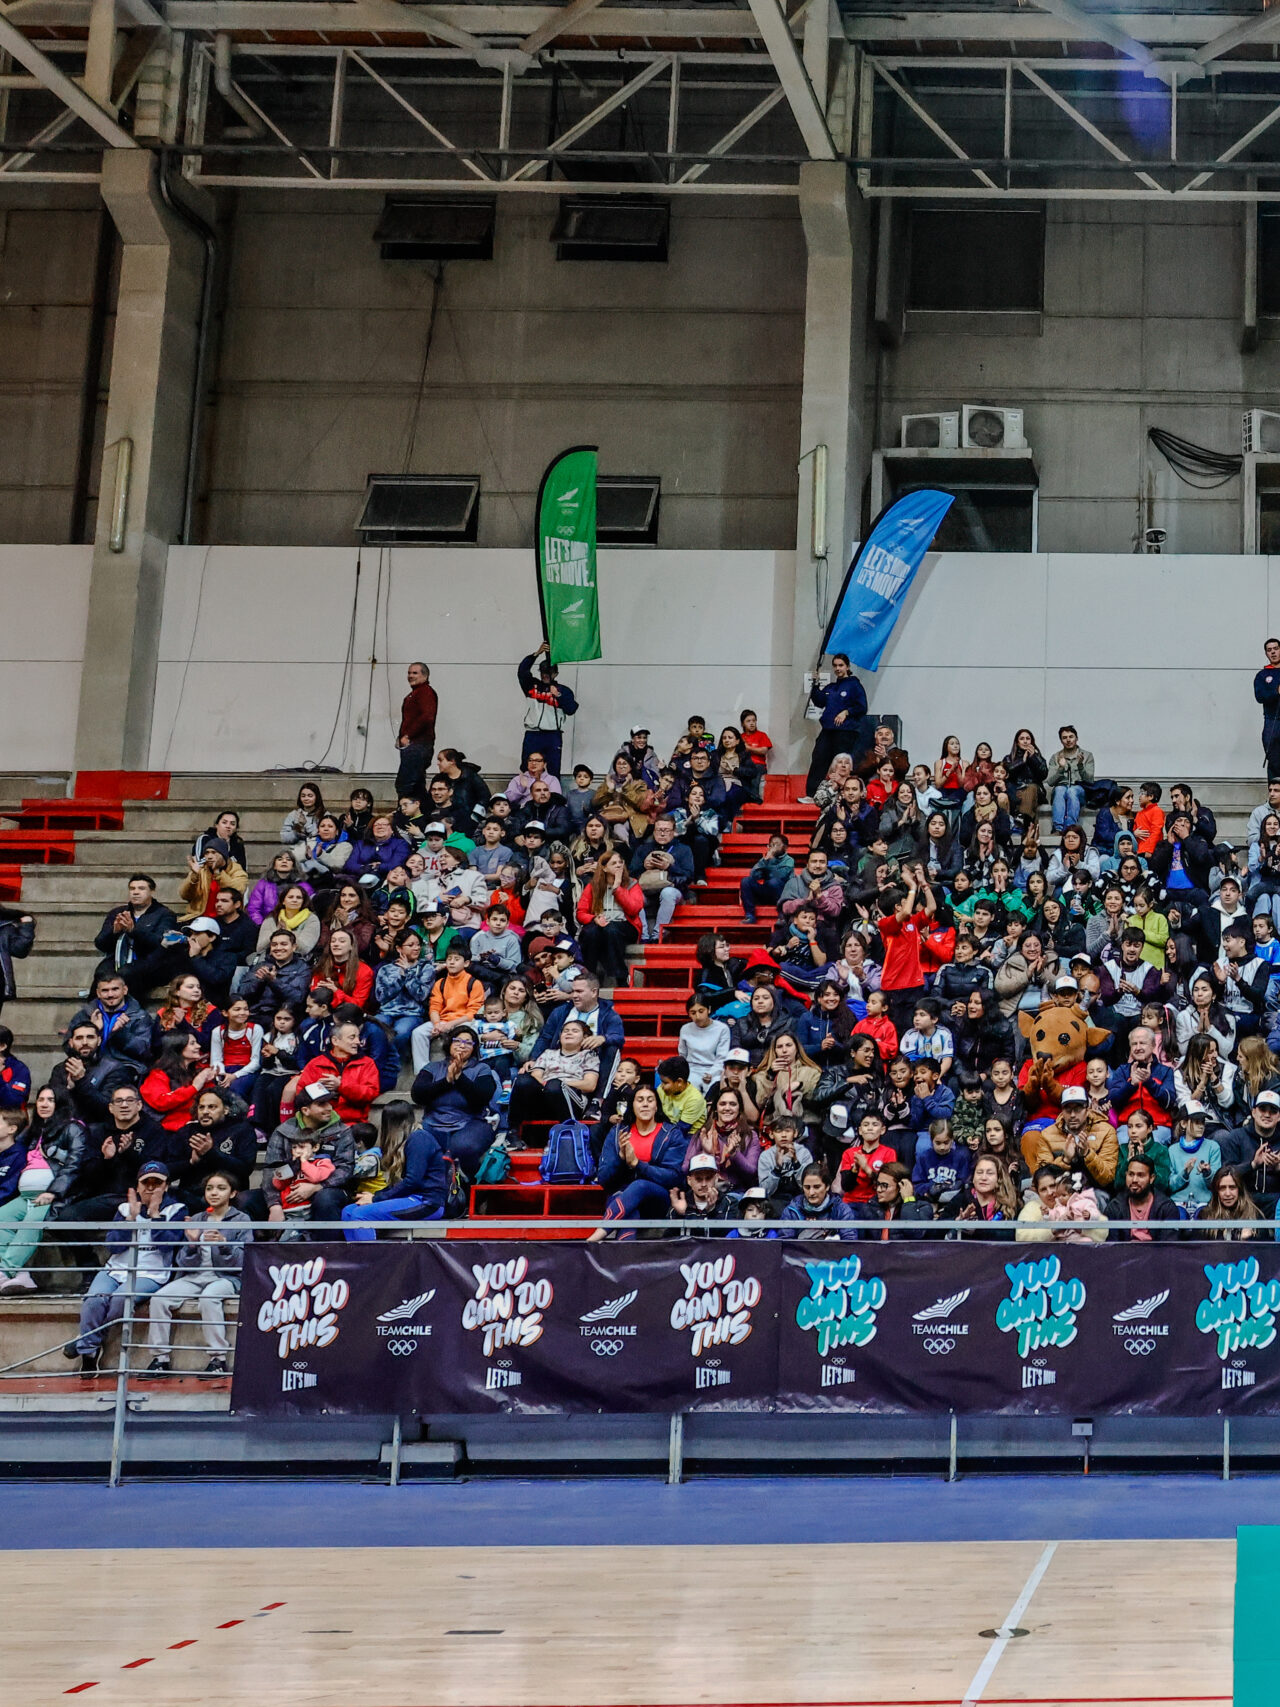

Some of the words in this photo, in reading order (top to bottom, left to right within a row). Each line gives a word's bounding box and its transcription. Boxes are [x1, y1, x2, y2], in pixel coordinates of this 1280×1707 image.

[545, 536, 570, 564] LET'S
[863, 544, 894, 573] LET'S
[268, 1256, 326, 1299] YOU
[472, 1256, 529, 1300] YOU
[679, 1254, 736, 1298] YOU
[804, 1254, 861, 1298] YOU
[1004, 1254, 1061, 1299] YOU
[1204, 1256, 1260, 1301] YOU
[257, 1293, 309, 1332] CAN
[312, 1279, 350, 1311] DO
[461, 1293, 512, 1331] CAN
[515, 1279, 554, 1311] DO
[670, 1293, 721, 1331] CAN
[723, 1276, 762, 1309] DO
[796, 1295, 847, 1331] CAN
[848, 1277, 886, 1311] DO
[996, 1294, 1048, 1332] CAN
[1048, 1277, 1087, 1311] DO
[1195, 1295, 1247, 1333] CAN
[277, 1312, 340, 1359] THIS
[376, 1325, 432, 1336] TEAMCHILE
[481, 1312, 543, 1357] THIS
[579, 1325, 637, 1336] TEAMCHILE
[690, 1312, 752, 1356] THIS
[816, 1312, 878, 1357] THIS
[912, 1324, 969, 1335] TEAMCHILE
[1017, 1312, 1078, 1358] THIS
[1112, 1325, 1169, 1336] TEAMCHILE
[1216, 1314, 1278, 1359] THIS
[282, 1369, 305, 1392] LET'S
[486, 1367, 508, 1390] LET'S
[695, 1367, 718, 1389] LET'S
[821, 1365, 843, 1388] LET'S
[1022, 1366, 1043, 1389] LET'S
[1222, 1367, 1243, 1390] LET'S
